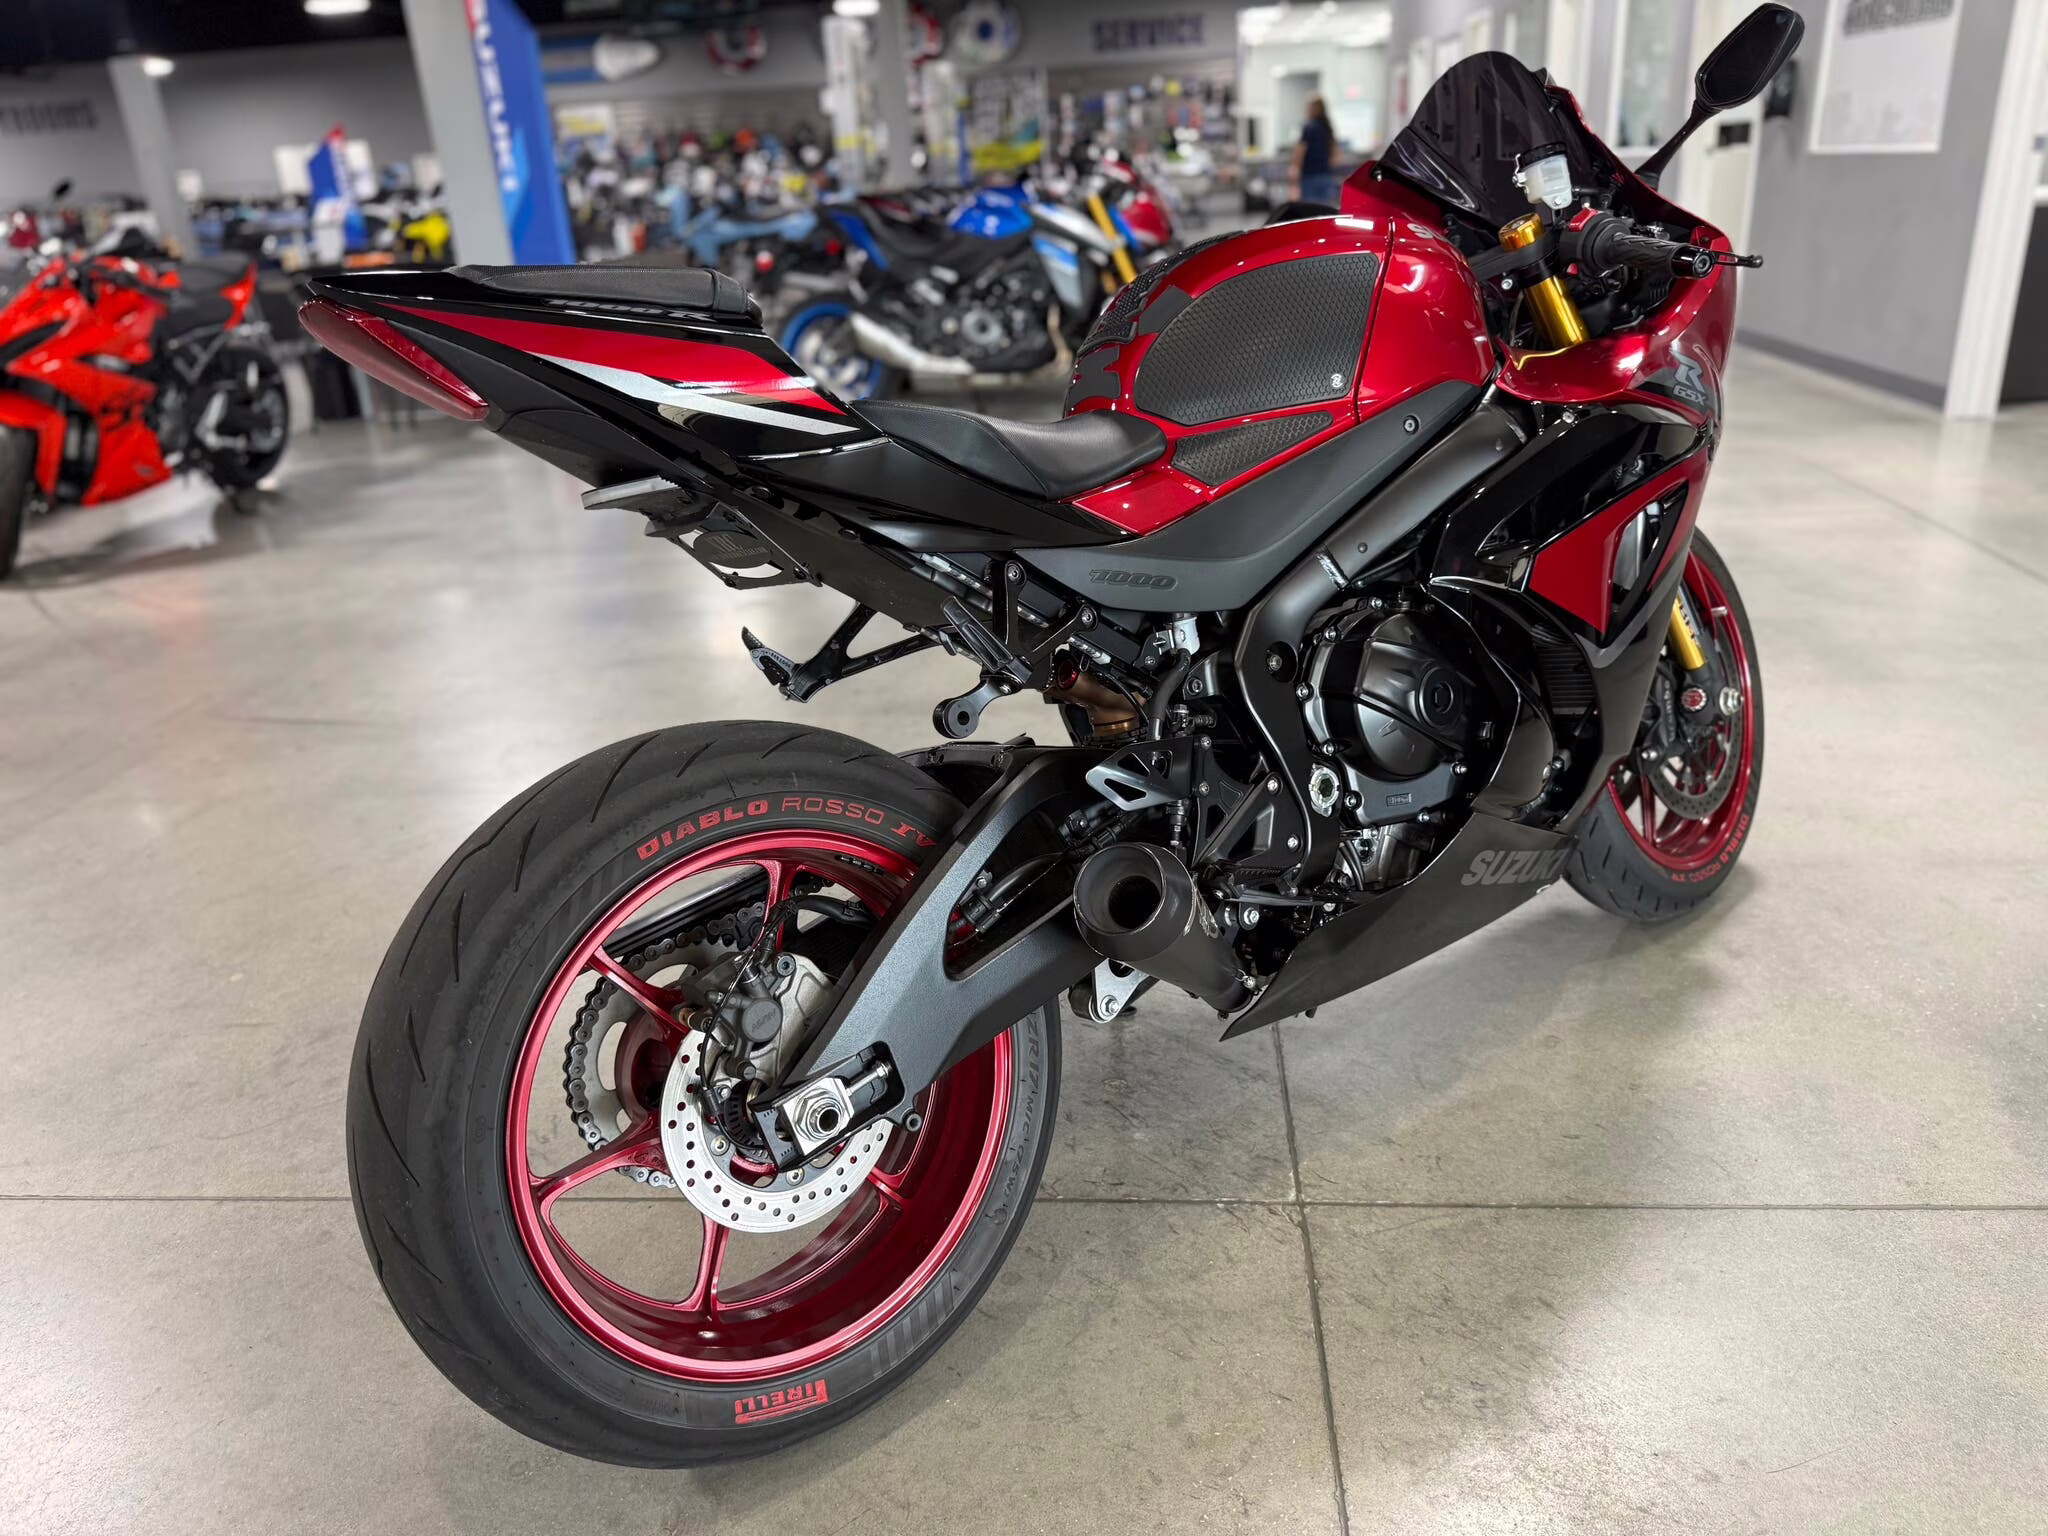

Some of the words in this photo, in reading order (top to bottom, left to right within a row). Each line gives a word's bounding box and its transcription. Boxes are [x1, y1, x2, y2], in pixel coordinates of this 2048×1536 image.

[1673, 385, 1707, 406] GSX
[1088, 569, 1179, 592] 1000
[636, 799, 769, 861] DIABLO
[780, 797, 886, 825] ROSSO
[734, 1379, 829, 1425] PIRELLI
